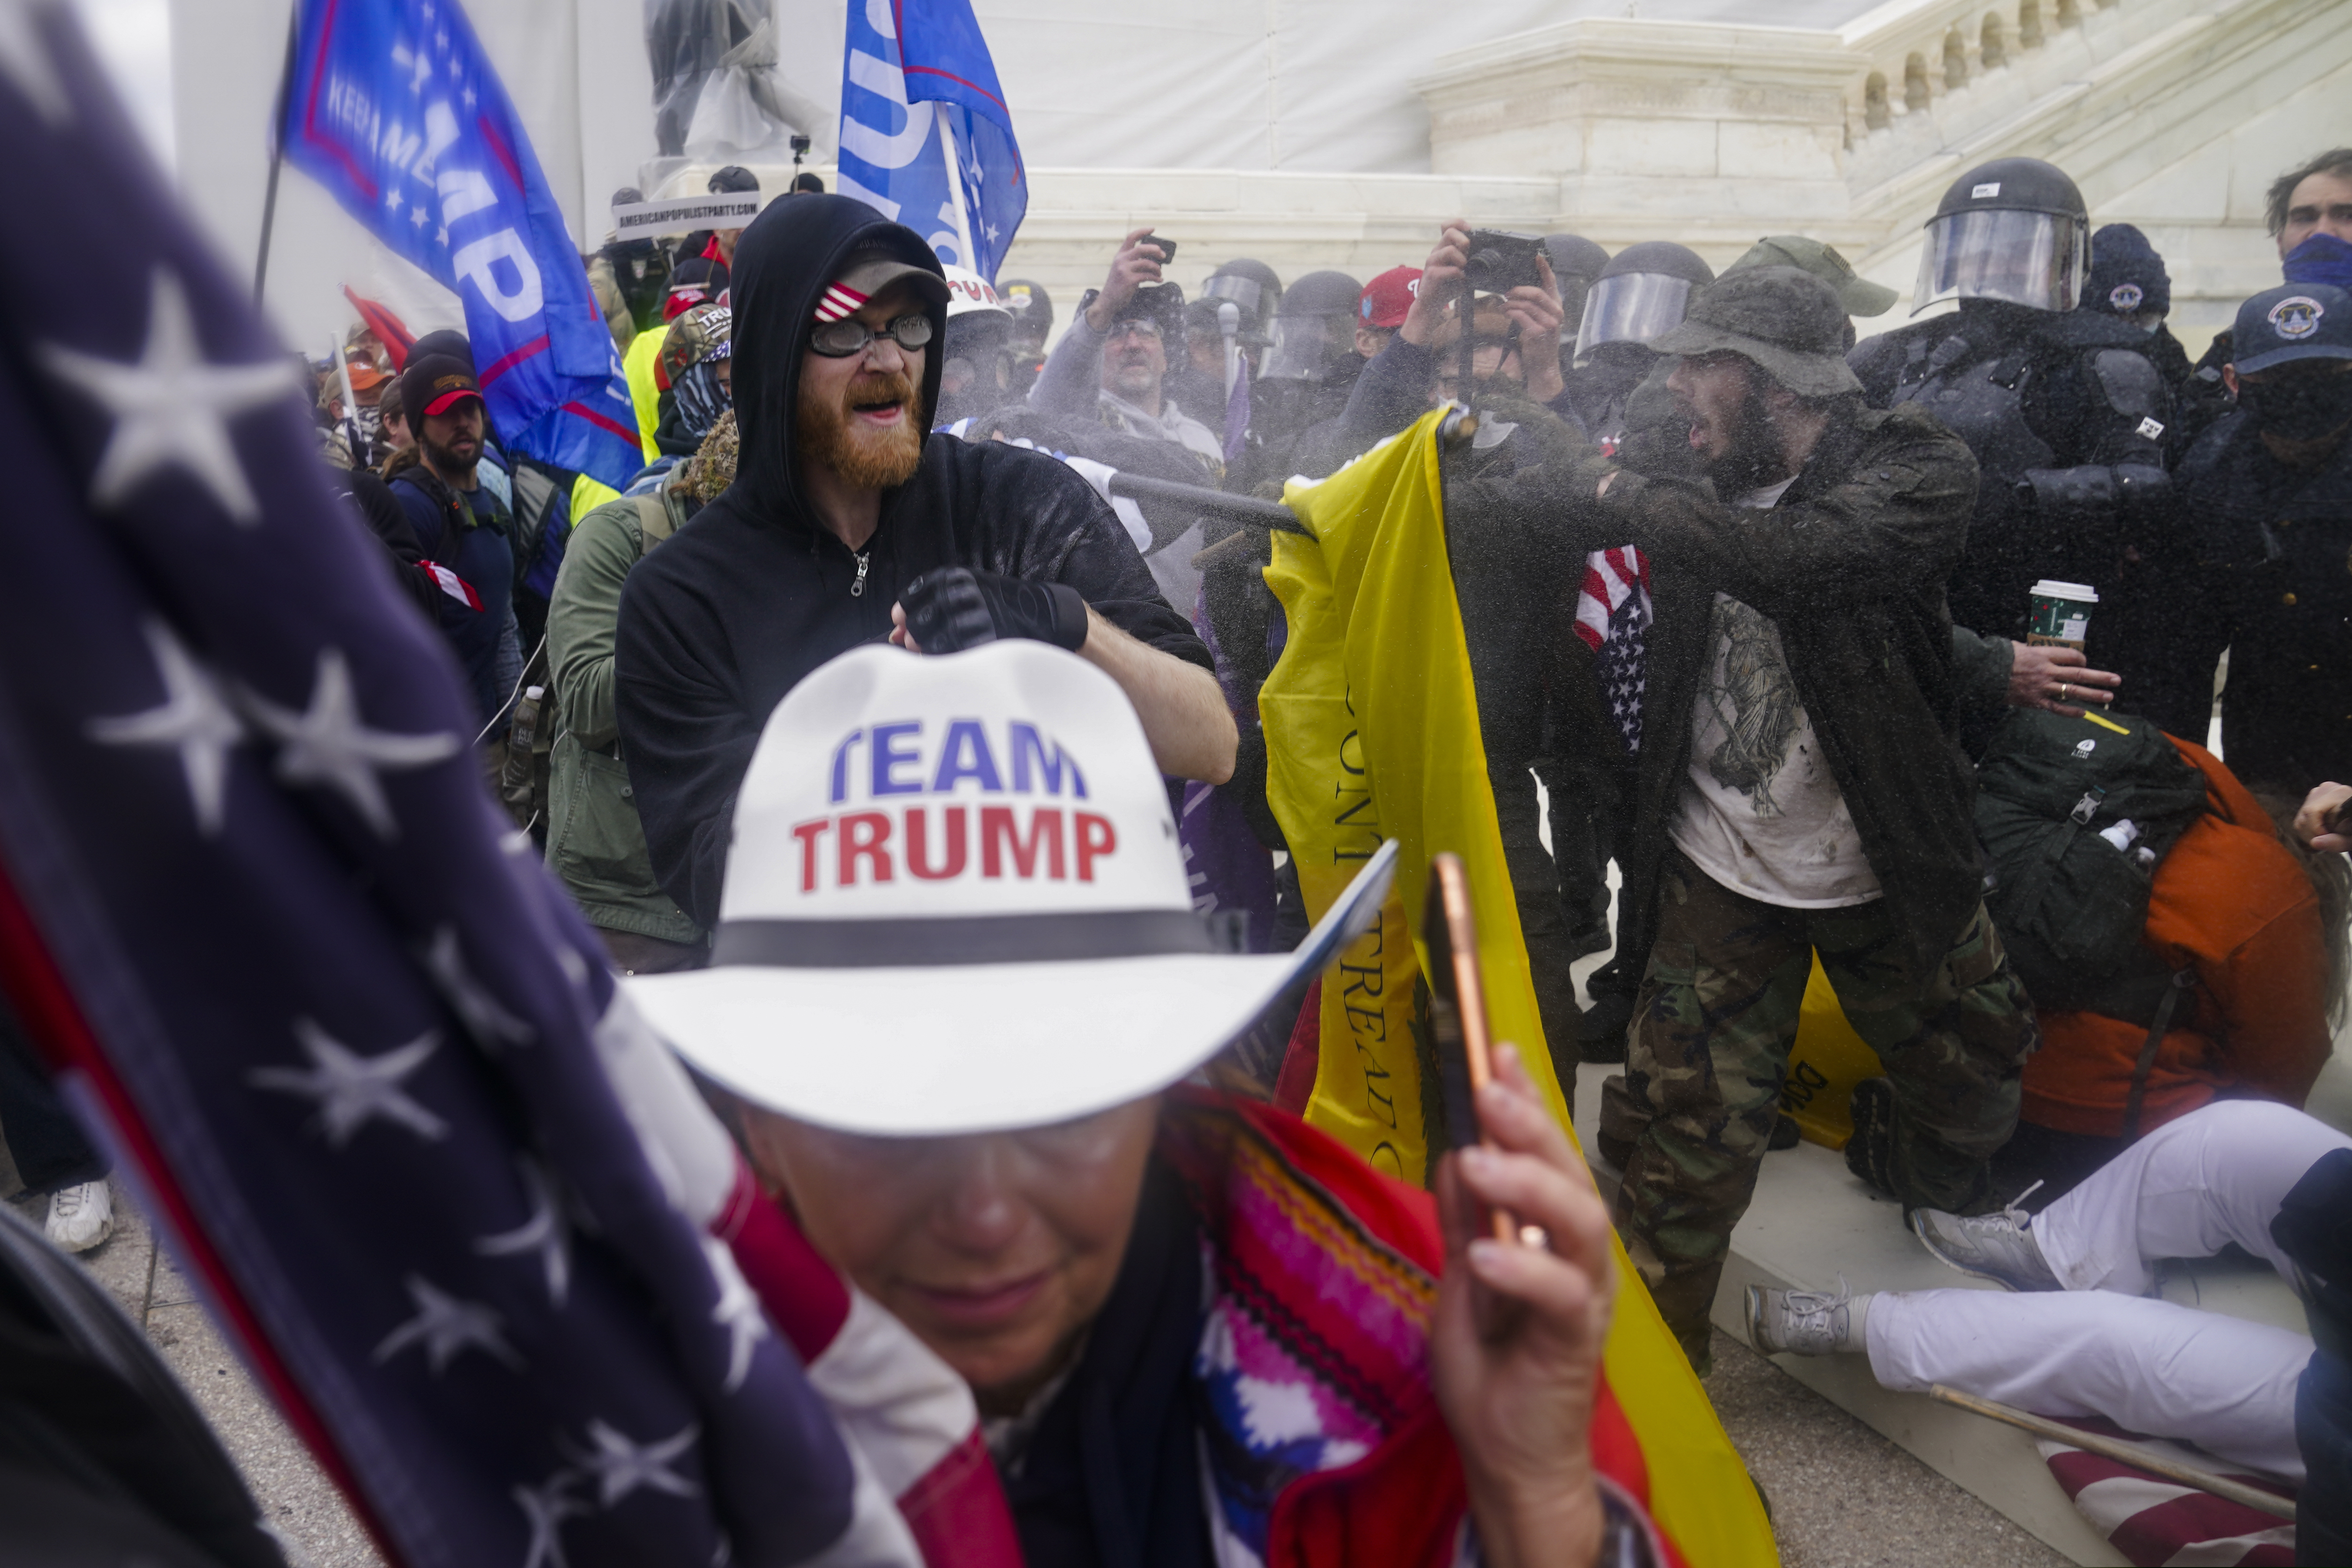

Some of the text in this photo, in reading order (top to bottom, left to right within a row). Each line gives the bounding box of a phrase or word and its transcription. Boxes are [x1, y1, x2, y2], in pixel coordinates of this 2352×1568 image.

[697, 307, 731, 327] TRU
[828, 718, 1089, 804] TEAM
[791, 804, 1118, 894] TRUMP
